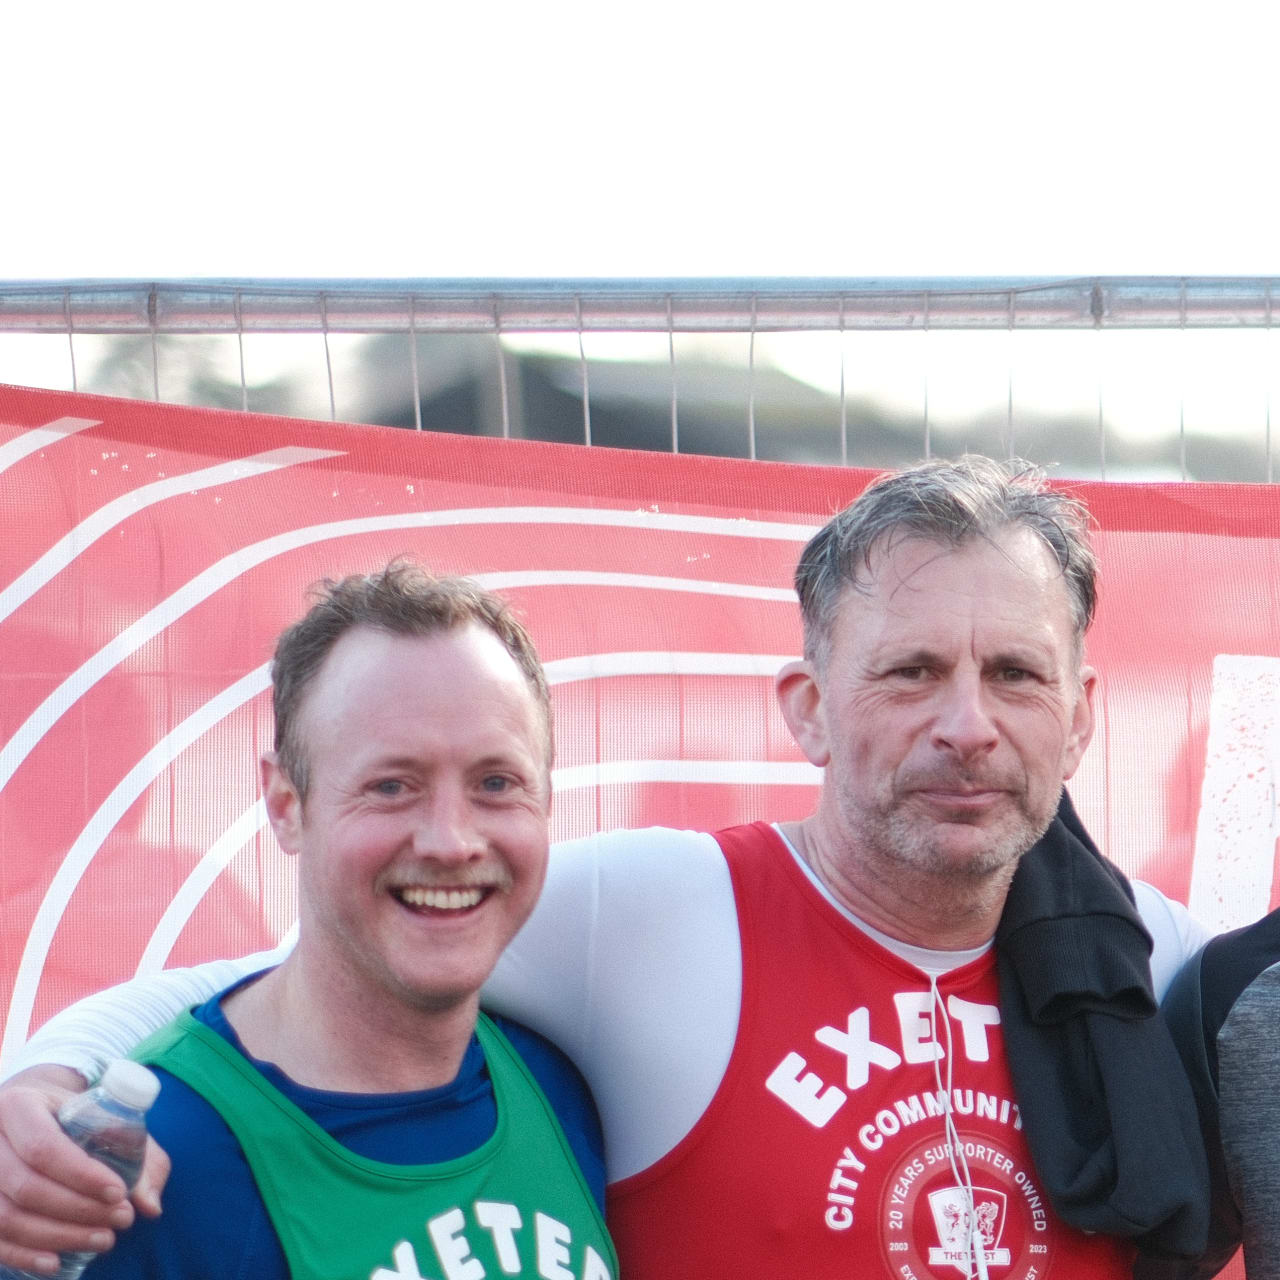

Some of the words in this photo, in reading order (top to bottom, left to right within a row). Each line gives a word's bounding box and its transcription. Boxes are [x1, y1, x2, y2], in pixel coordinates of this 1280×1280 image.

[766, 991, 1001, 1128] EXET
[825, 1147, 867, 1231] CITY
[858, 1089, 1023, 1152] COMMUNIT
[891, 1158, 925, 1209] YEARS
[889, 1211, 903, 1229] 20
[1014, 1171, 1047, 1231] OWNED
[944, 1251, 962, 1260] THE
